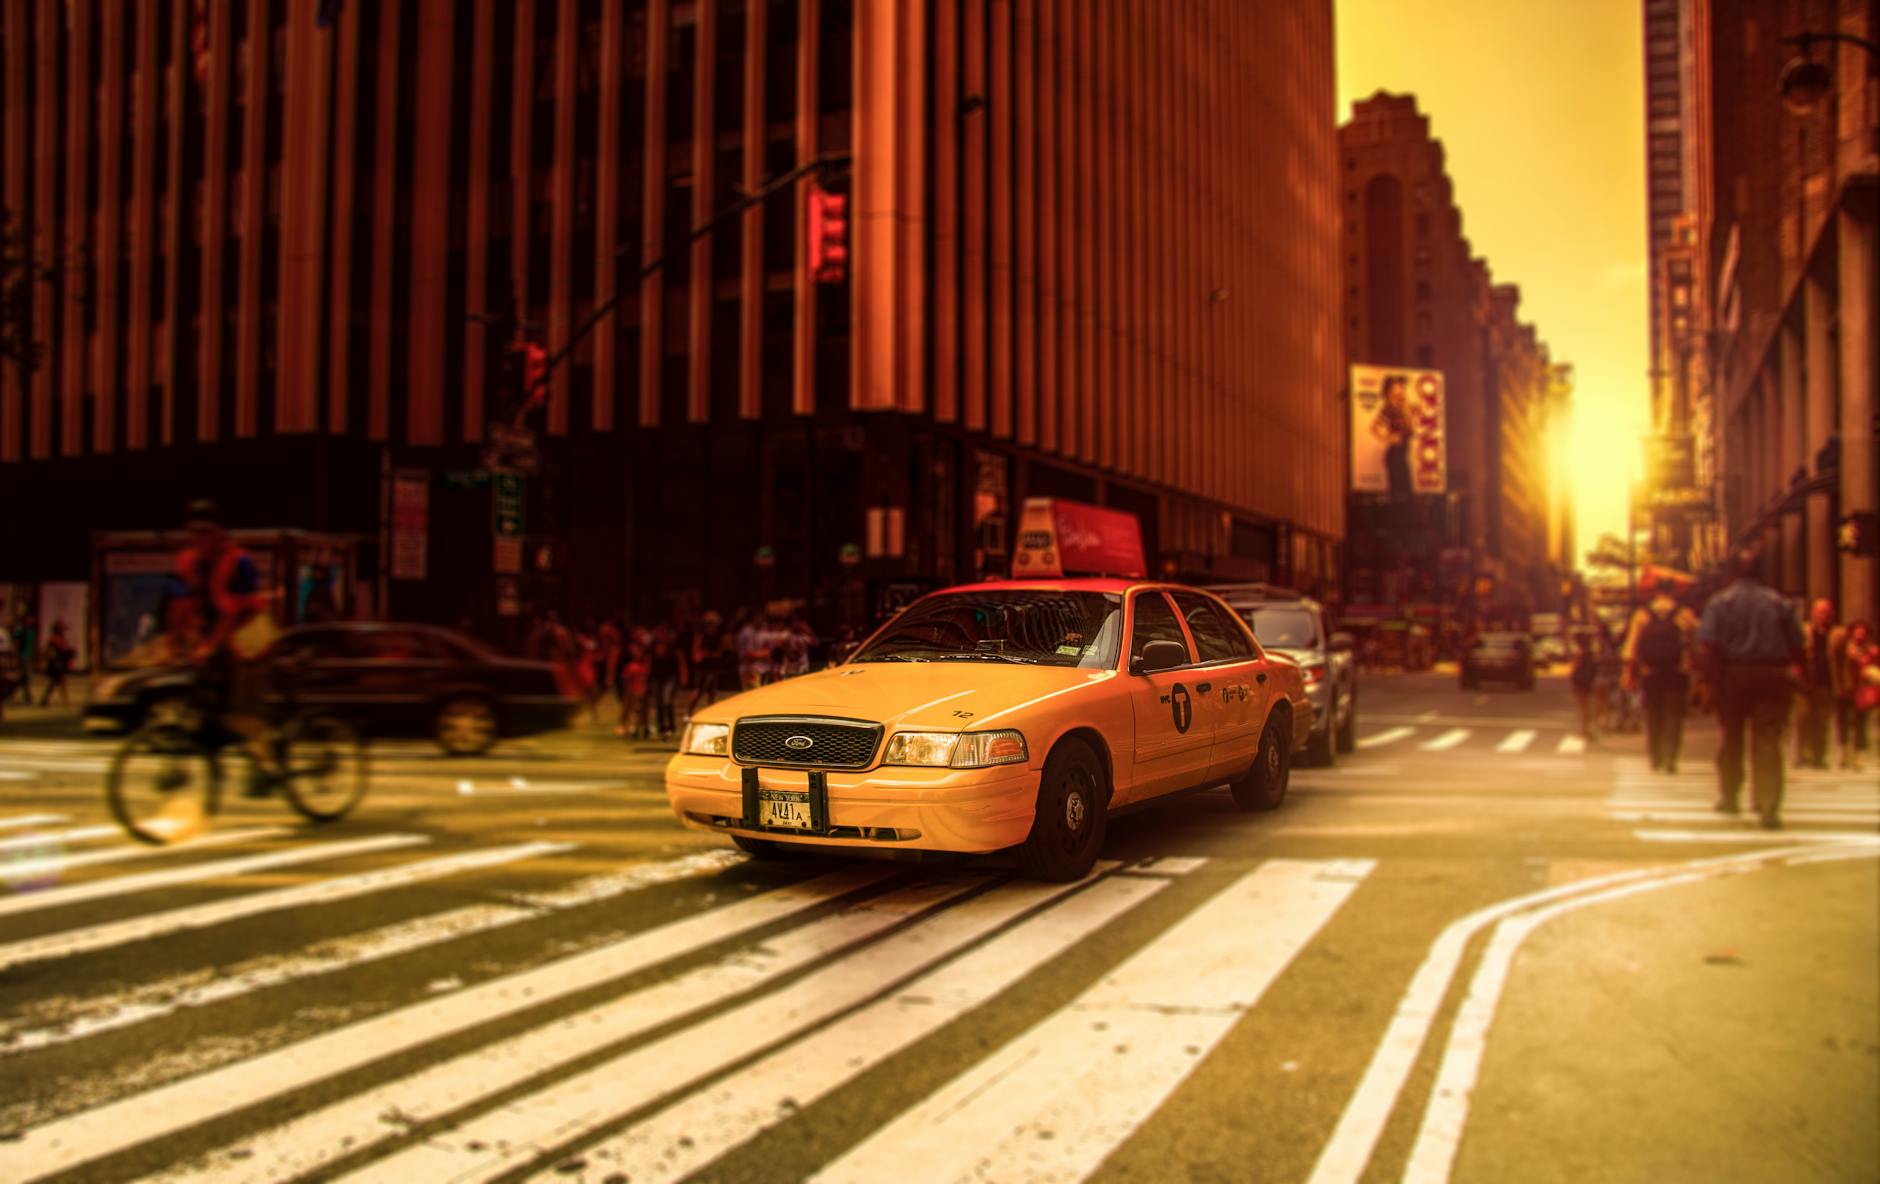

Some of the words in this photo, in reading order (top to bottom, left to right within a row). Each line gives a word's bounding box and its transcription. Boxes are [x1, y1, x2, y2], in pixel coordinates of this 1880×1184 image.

[952, 710, 975, 719] 12
[791, 738, 807, 747] Ford
[770, 793, 785, 802] NEW
